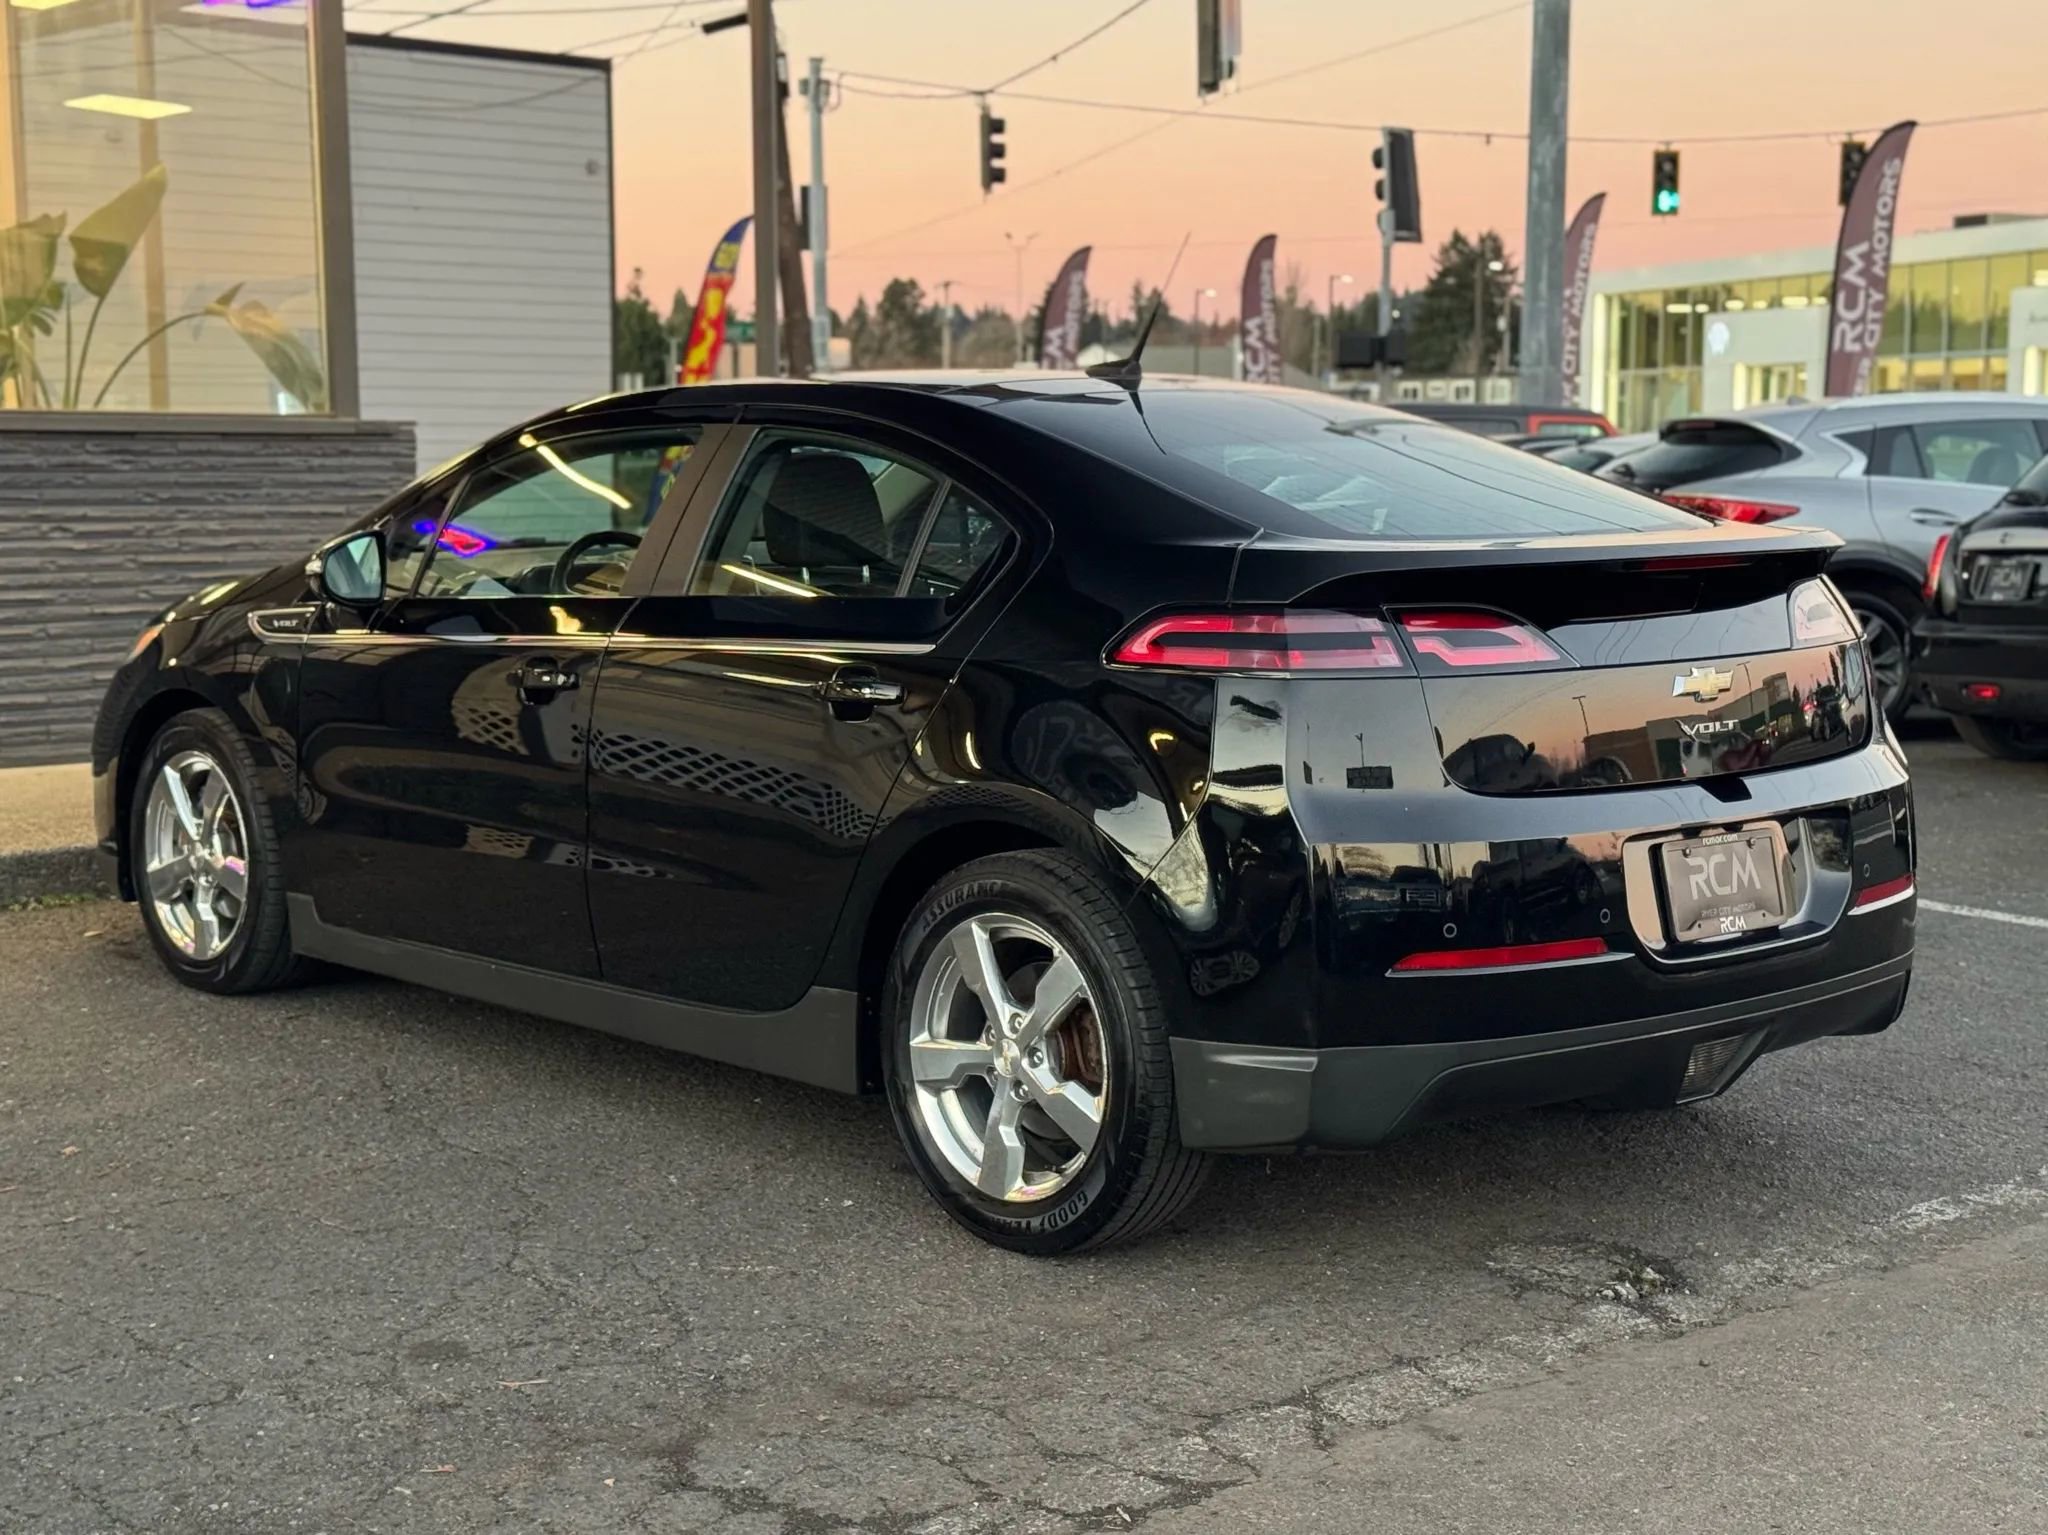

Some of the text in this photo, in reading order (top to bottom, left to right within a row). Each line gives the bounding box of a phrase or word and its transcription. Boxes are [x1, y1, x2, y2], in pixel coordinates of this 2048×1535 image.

[1570, 223, 1597, 316] MOTORS
[1864, 157, 1902, 349] CITY MOTORS
[1832, 241, 1870, 353] RCM
[1675, 719, 1739, 741] VOLT
[1688, 850, 1761, 900] RCM
[1719, 905, 1732, 916] CITY
[1733, 901, 1756, 912] MOTORS
[1719, 916, 1746, 933] RCM
